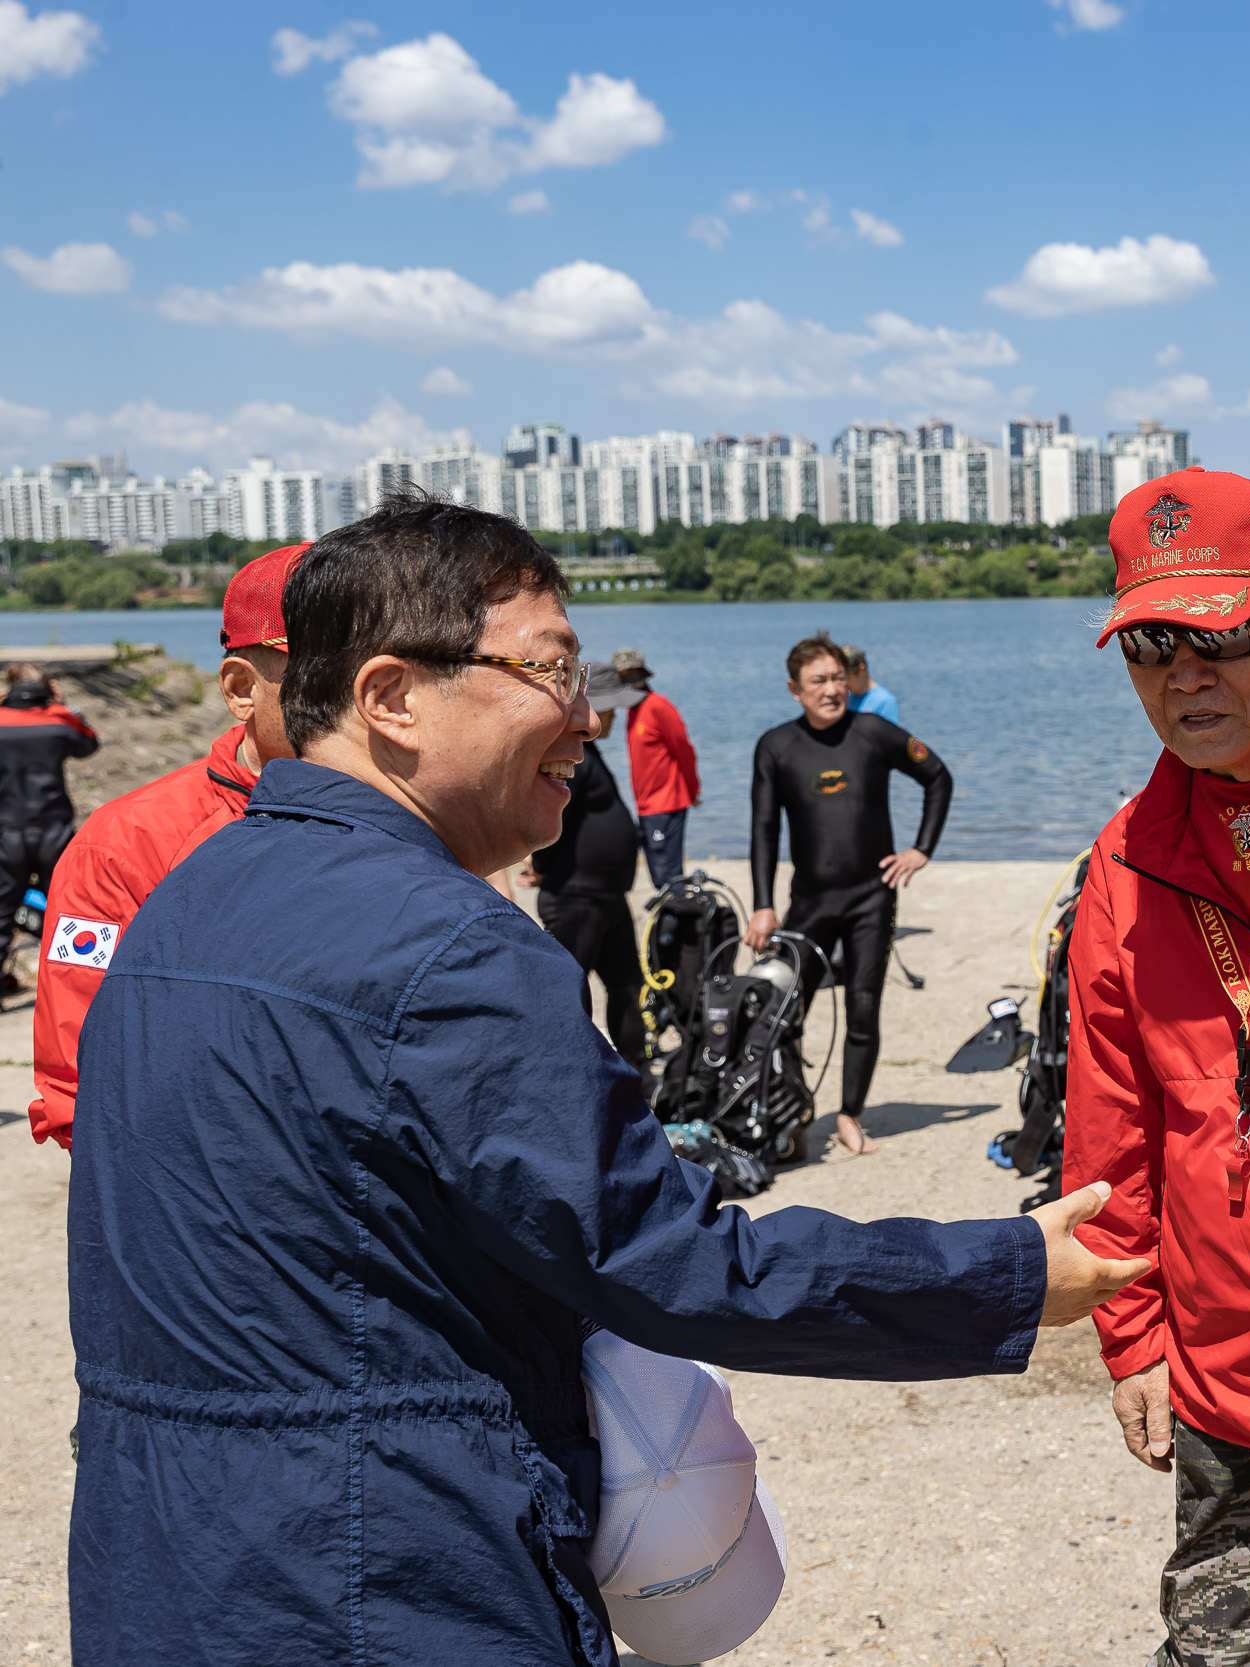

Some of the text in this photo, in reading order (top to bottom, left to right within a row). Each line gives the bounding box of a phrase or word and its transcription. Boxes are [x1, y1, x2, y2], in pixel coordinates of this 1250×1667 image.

[1151, 549, 1184, 568] MARINE
[1186, 546, 1220, 562] CORPS
[1216, 941, 1242, 987] R.O.K
